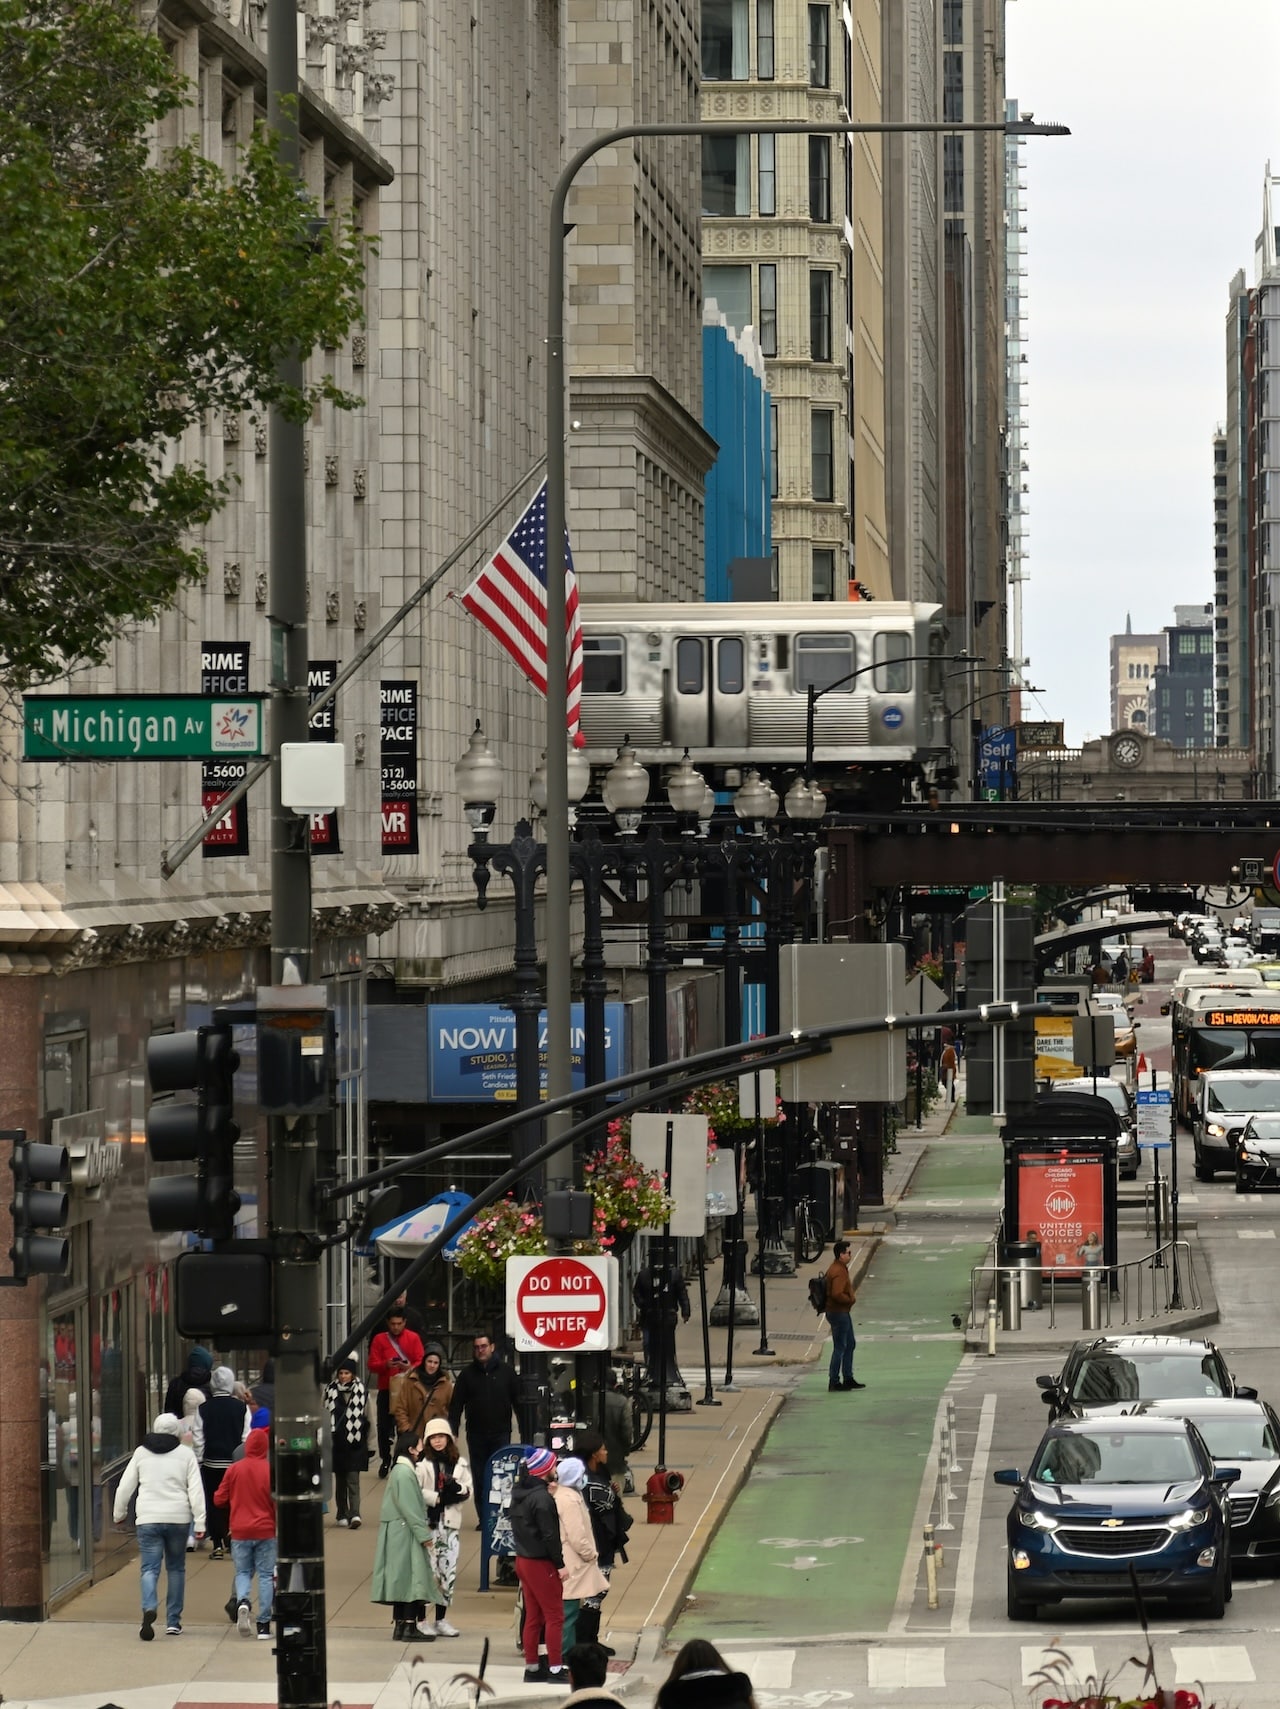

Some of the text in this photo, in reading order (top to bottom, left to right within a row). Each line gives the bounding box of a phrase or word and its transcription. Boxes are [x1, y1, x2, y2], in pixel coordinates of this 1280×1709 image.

[201, 653, 242, 670] RIME
[202, 676, 246, 692] FFICE
[380, 689, 412, 703] RIME
[381, 708, 415, 722] FFICE
[33, 709, 204, 752] N Michigan Av
[380, 726, 413, 740] PACE
[983, 743, 1010, 756] Self
[1211, 1012, 1225, 1025] 151
[439, 1028, 506, 1050] NOW
[1039, 1229, 1082, 1237] VOICES
[529, 1275, 592, 1291] DO NOT
[536, 1317, 587, 1331] ENTER
